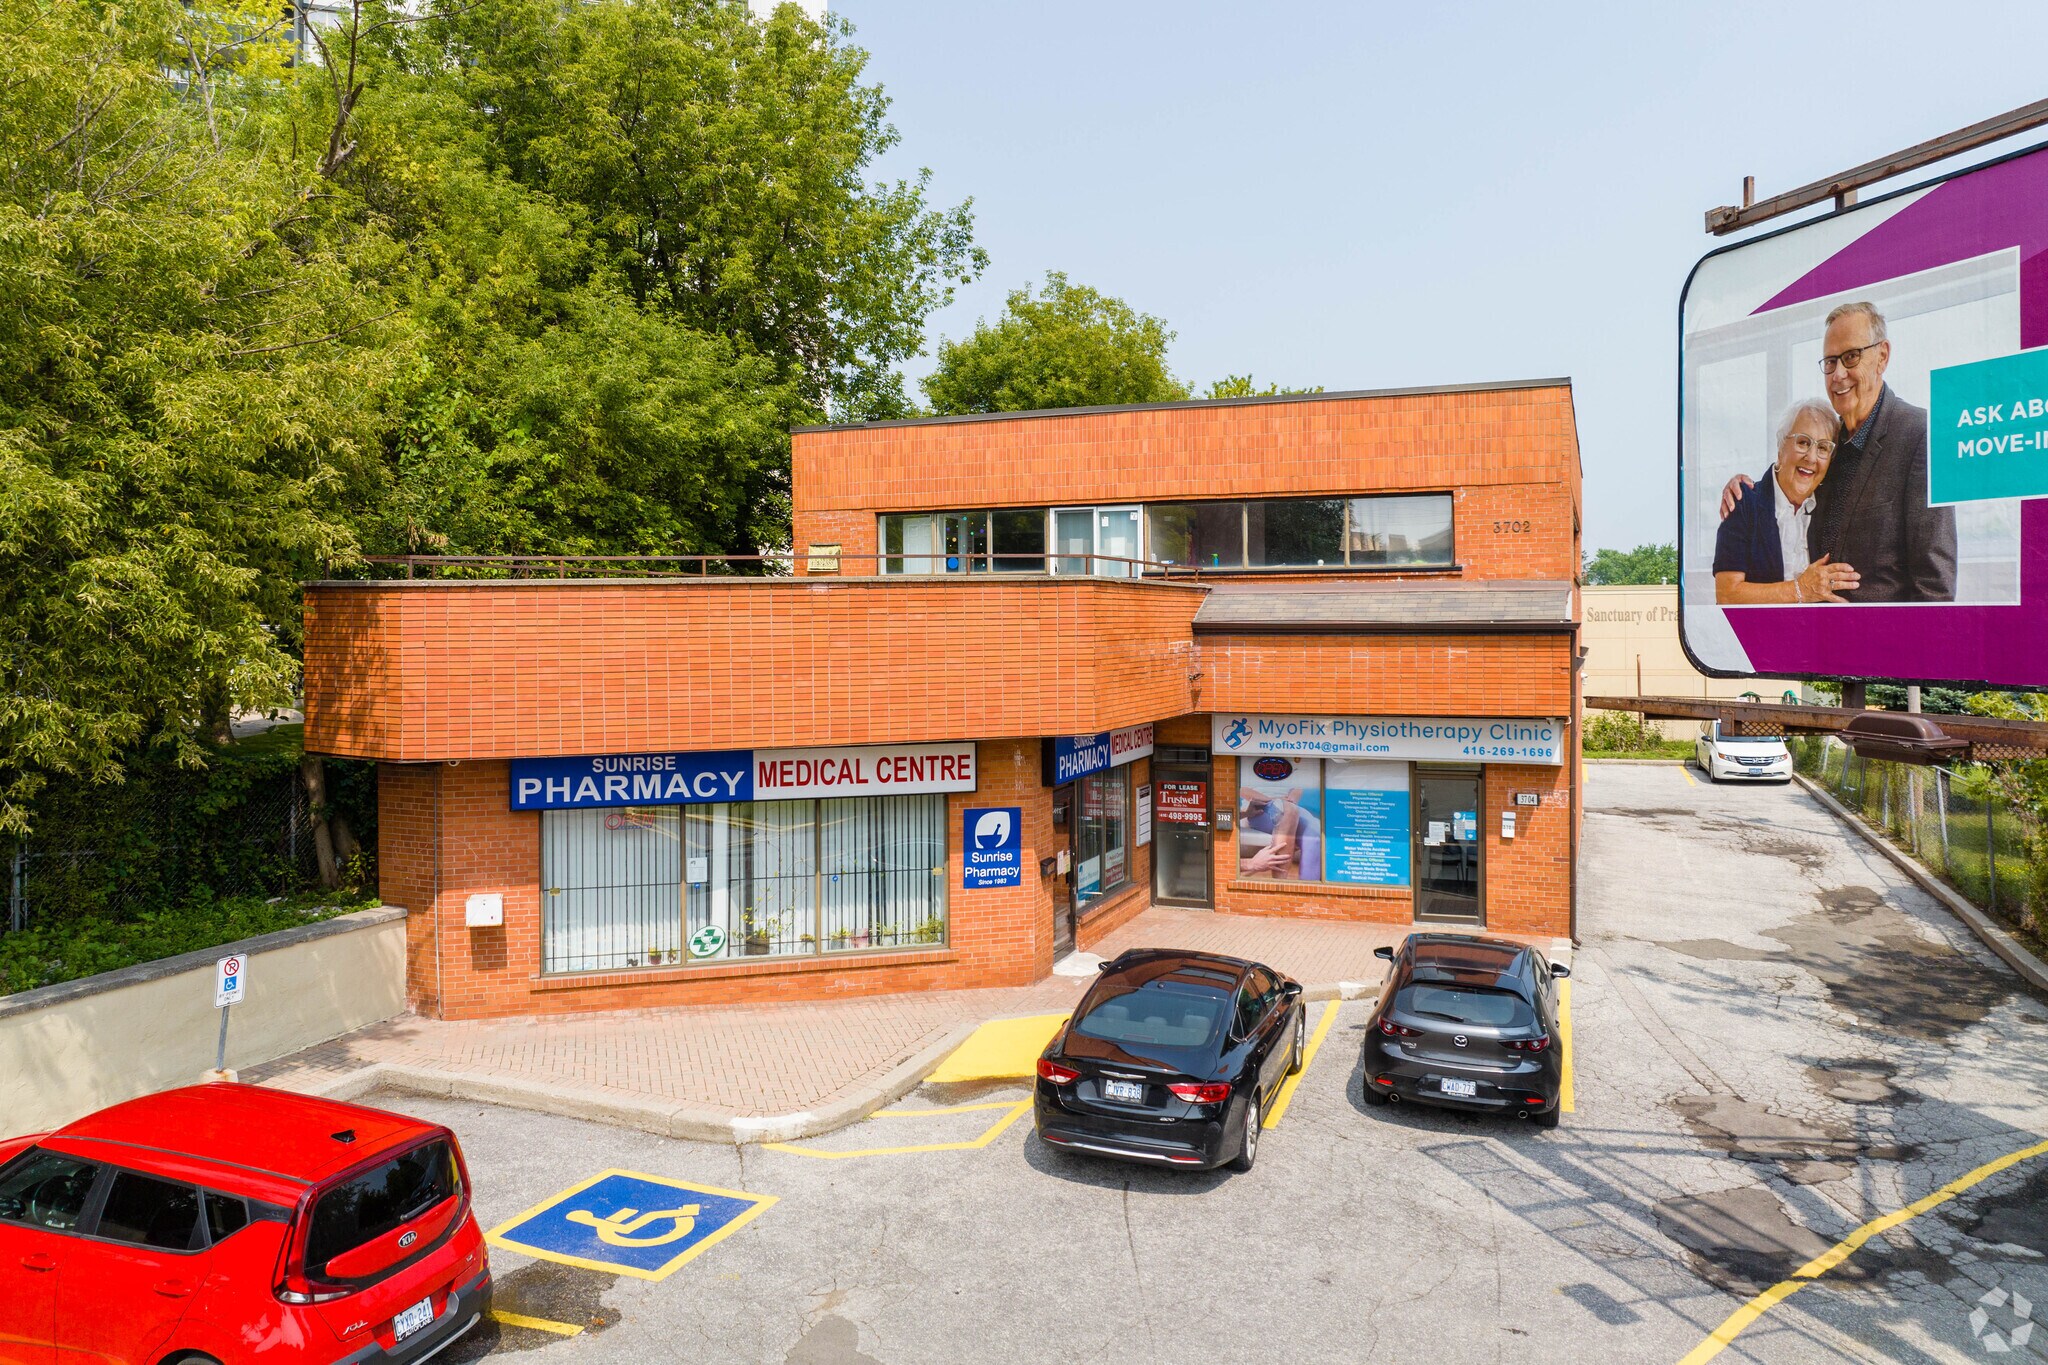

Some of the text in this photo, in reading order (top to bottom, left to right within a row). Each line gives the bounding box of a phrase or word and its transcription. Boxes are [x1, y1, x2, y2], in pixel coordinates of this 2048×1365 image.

[1957, 398, 2048, 427] ASK AB
[1493, 520, 1531, 533] 3702
[1587, 607, 1642, 625] Sanctuary
[1646, 606, 1658, 621] of
[1259, 719, 1552, 743] MyoFix Physiotherapy Clinic
[1111, 726, 1152, 756] MEDICAL CENTRE
[1259, 741, 1390, 753] myofix3704@gmail.com
[1462, 746, 1552, 757] 416-269-1696
[592, 756, 676, 773] SUNRISE
[1059, 743, 1109, 779] PHARMACY
[759, 754, 971, 788] MEDICAL CENTRE
[1255, 763, 1288, 775] OPEN
[518, 770, 745, 804] PHARMACY
[1160, 791, 1199, 805] Trustwell
[1520, 795, 1535, 803] 3704
[605, 812, 655, 830] OPEN
[1168, 812, 1203, 821] 498-9995
[971, 851, 1013, 863] Sunrise
[965, 866, 1020, 878] Pharmacy
[402, 1232, 416, 1246] KIA
